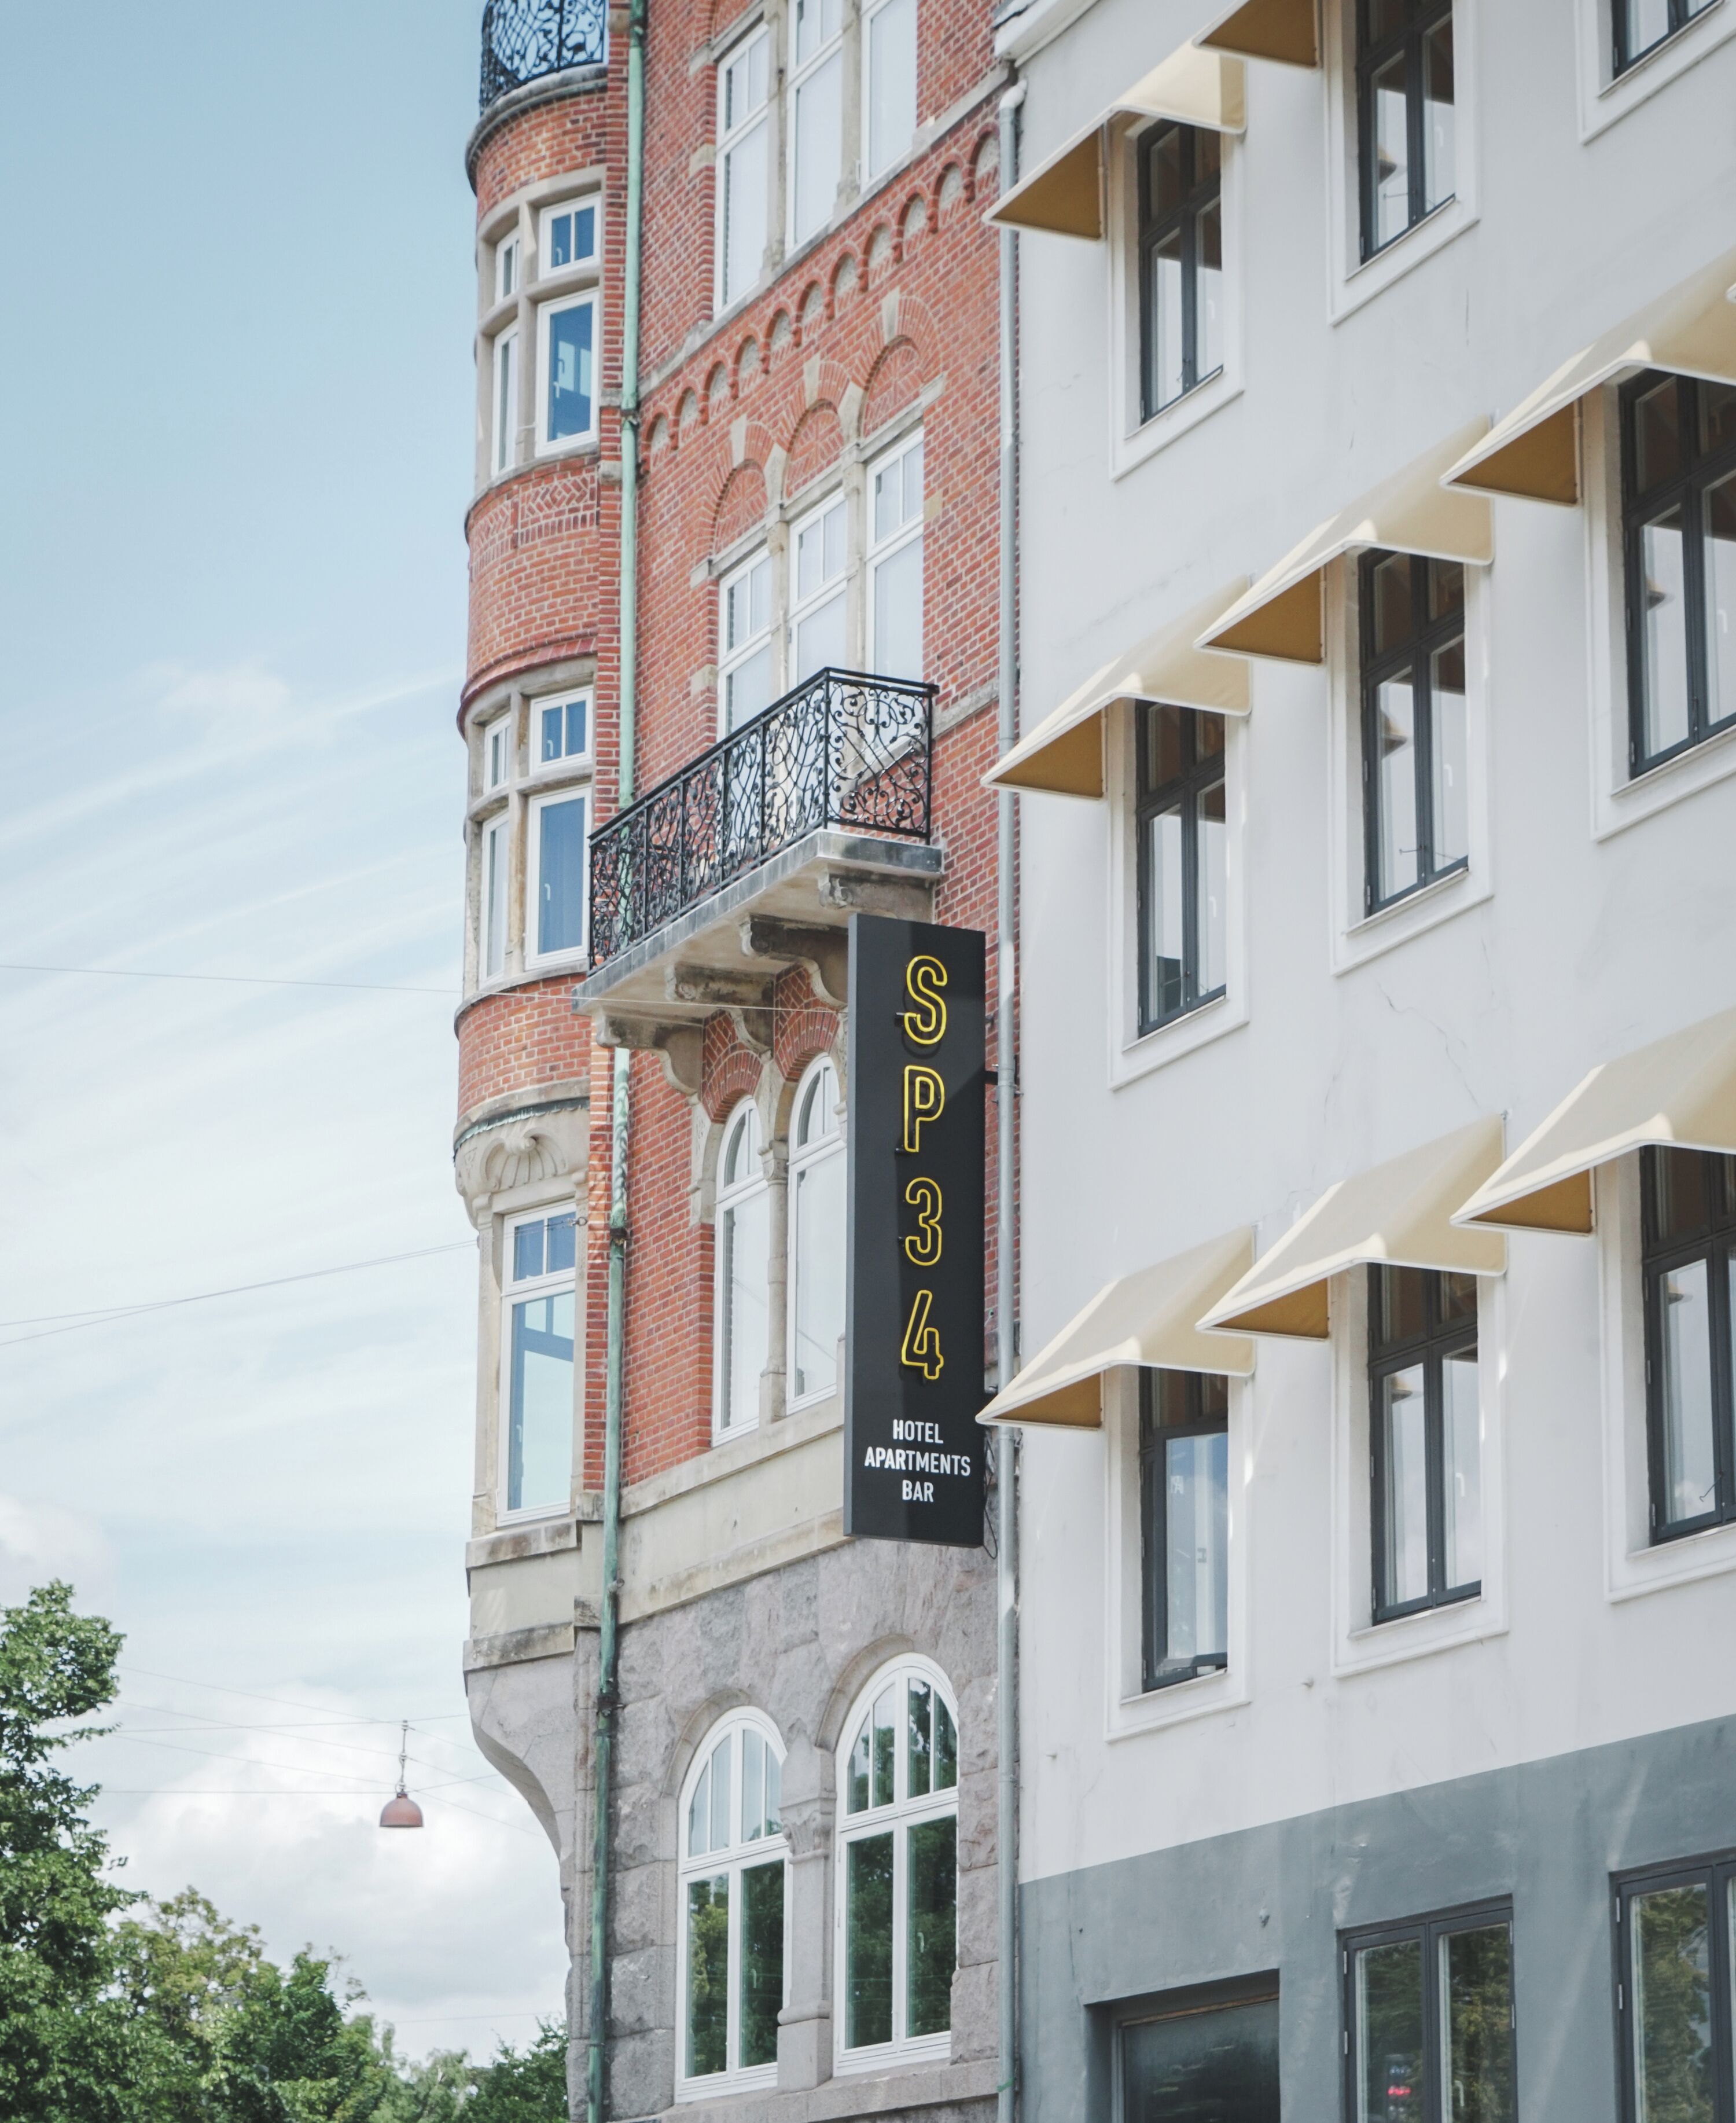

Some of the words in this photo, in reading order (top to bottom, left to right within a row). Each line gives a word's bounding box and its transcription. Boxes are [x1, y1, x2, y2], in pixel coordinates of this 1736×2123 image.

[901, 954, 948, 1380] SP34
[892, 1419, 944, 1444] HOTEL
[865, 1446, 971, 1476] APARTMENTS
[902, 1479, 934, 1503] BAR
